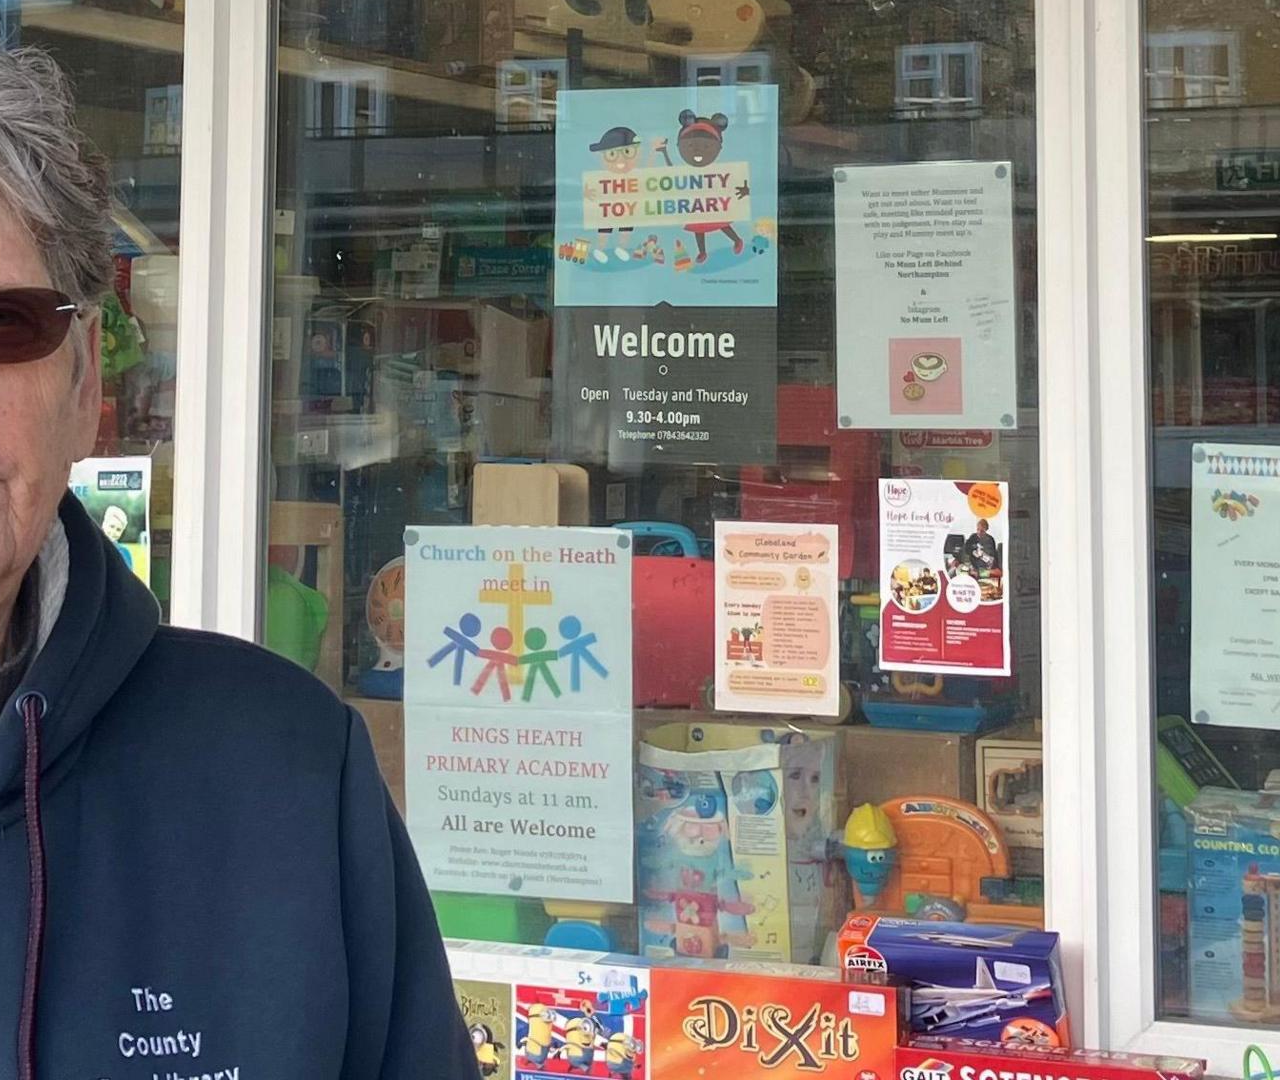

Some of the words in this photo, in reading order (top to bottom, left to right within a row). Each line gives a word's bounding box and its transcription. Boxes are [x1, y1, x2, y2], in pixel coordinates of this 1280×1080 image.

[599, 178, 638, 195] THE
[645, 173, 730, 192] COUNTY
[599, 202, 638, 218] TOY
[644, 196, 732, 217] LIBRARY
[934, 260, 962, 268] Behind
[593, 324, 735, 358] Welcome
[580, 387, 609, 403] Open
[622, 387, 668, 404] Tuesday
[671, 389, 692, 402] and
[696, 388, 749, 406] Thursday
[626, 410, 701, 427] 9.30-4.00pm
[618, 429, 655, 441] Telephone
[887, 483, 908, 496] Hope
[886, 510, 908, 522] Hope
[420, 544, 486, 562] Church
[492, 549, 515, 562] on
[522, 546, 552, 563] the
[559, 547, 616, 565] Heath
[739, 549, 780, 561] Community
[783, 551, 812, 561] Garden
[483, 577, 527, 592] meet
[533, 575, 550, 593] in
[1251, 672, 1264, 682] ALL
[451, 726, 510, 745] KINGS
[516, 729, 583, 748] HEATH
[426, 754, 510, 774] PRIMARY
[516, 759, 610, 780] ACADEMY
[437, 784, 512, 808] Sundays
[518, 790, 534, 806] at
[542, 792, 558, 807] 11
[565, 795, 599, 810] am.
[441, 814, 467, 832] All
[473, 819, 504, 834] are
[510, 818, 596, 840] Welcome
[1194, 838, 1254, 854] COUNTING
[847, 957, 885, 970] AIRFIX
[578, 971, 593, 985] 5+
[131, 987, 173, 1011] The
[119, 1029, 202, 1058] County
[958, 1037, 1071, 1055] SCIENCE
